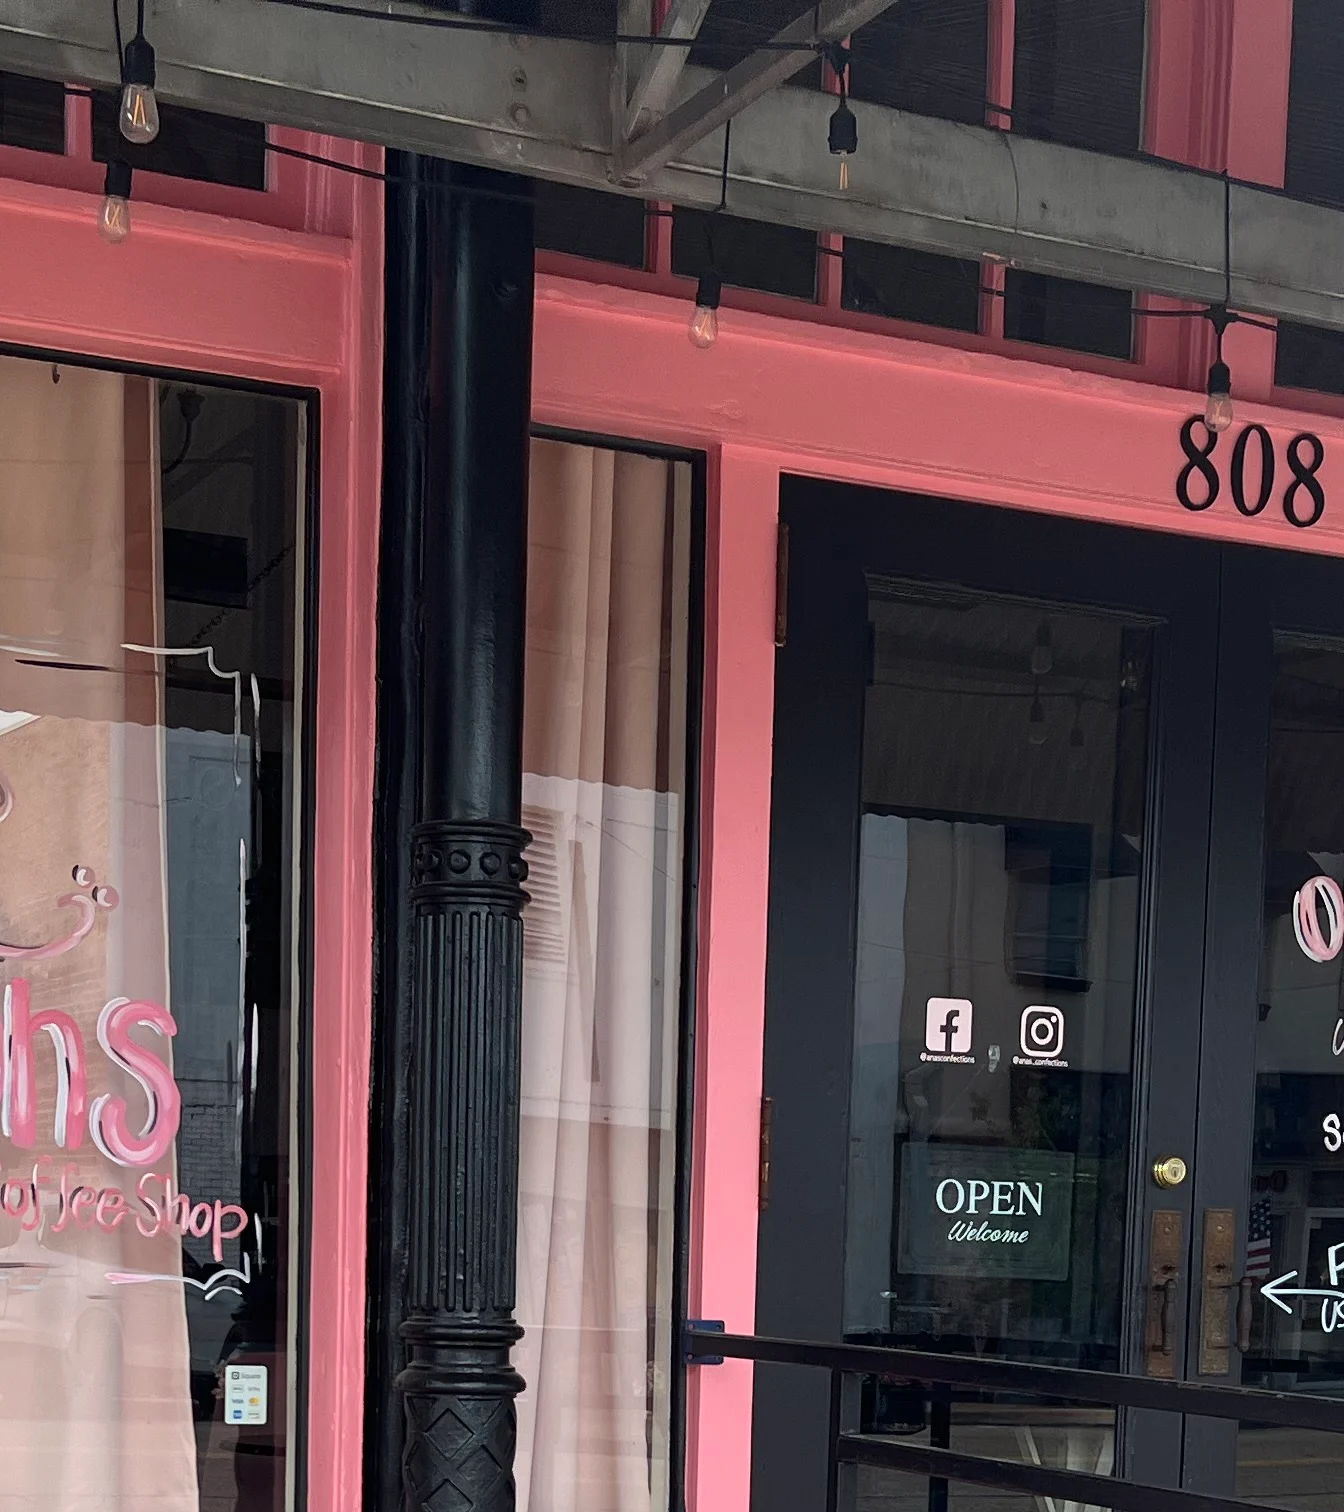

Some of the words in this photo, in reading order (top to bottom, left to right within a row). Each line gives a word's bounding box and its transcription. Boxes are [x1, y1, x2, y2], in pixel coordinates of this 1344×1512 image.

[1176, 414, 1325, 527] 808
[136, 1172, 249, 1262] Shop
[936, 1179, 1042, 1216] OPEN
[947, 1220, 1029, 1243] Welcome
